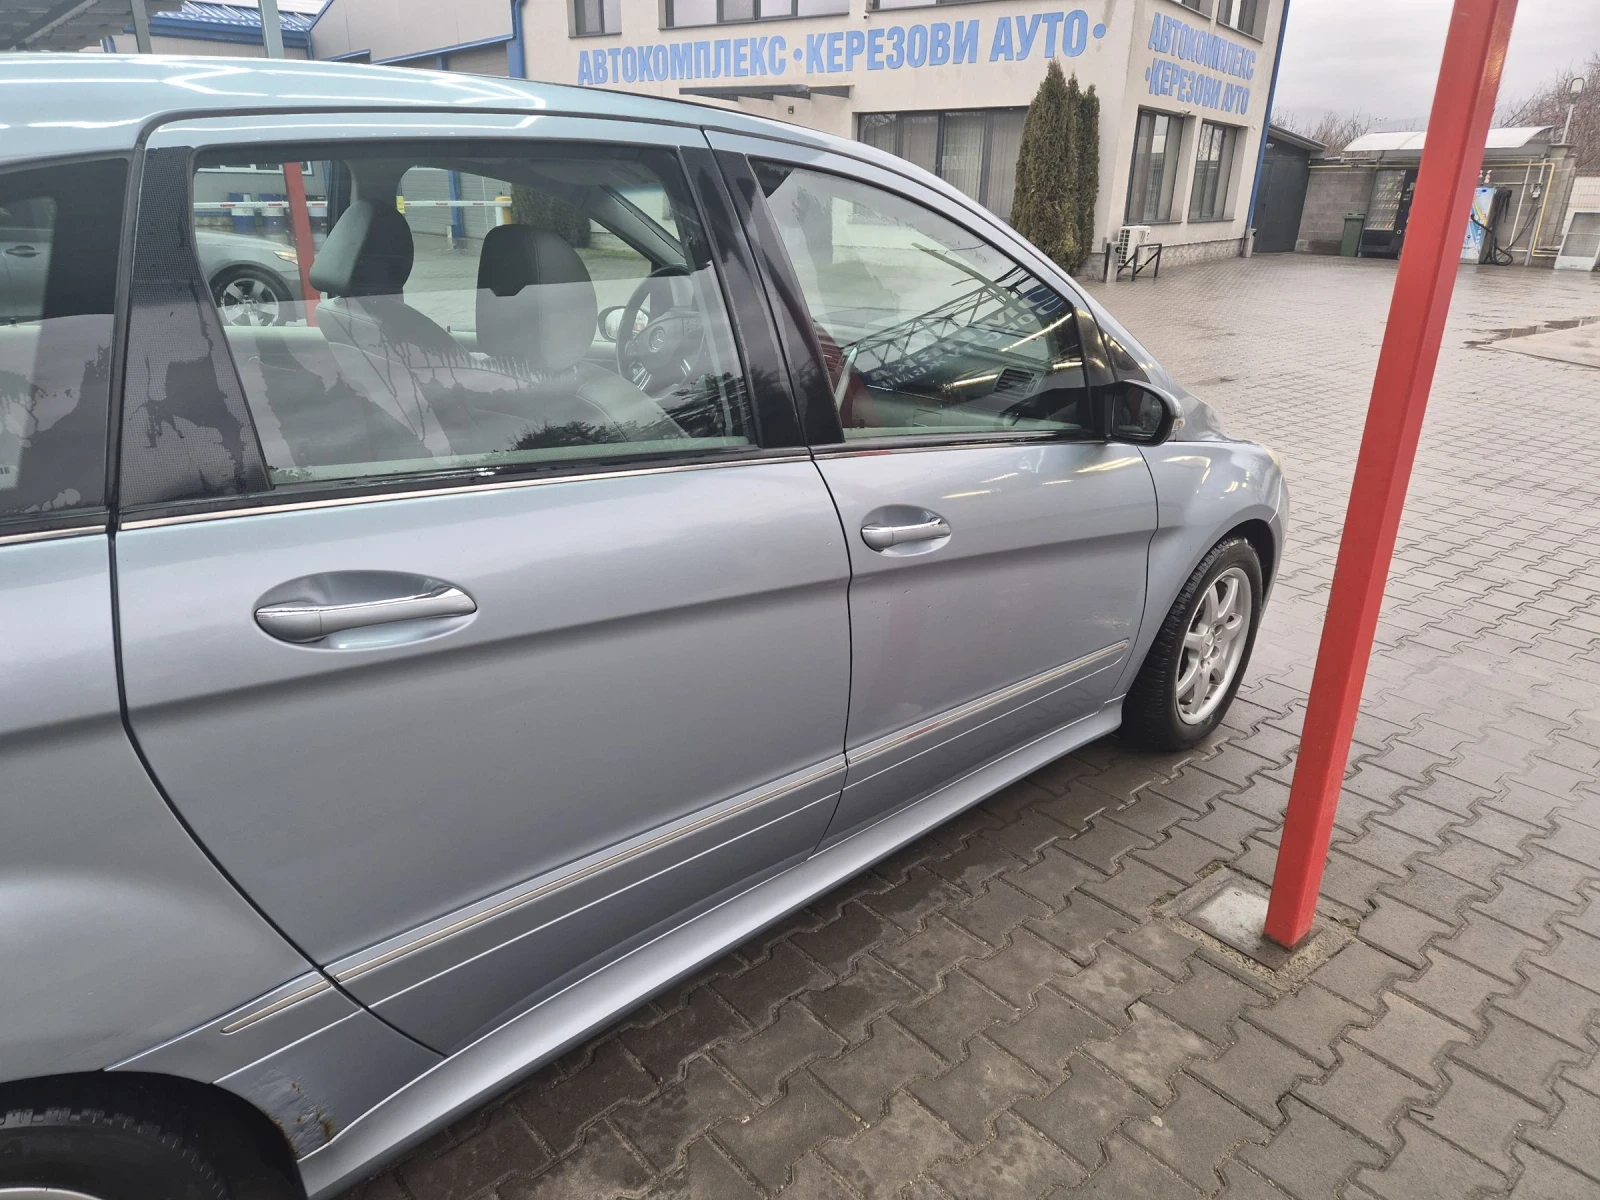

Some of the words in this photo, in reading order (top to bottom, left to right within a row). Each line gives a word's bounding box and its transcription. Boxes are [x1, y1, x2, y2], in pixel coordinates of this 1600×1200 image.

[578, 35, 786, 85] АВТОКОМПЛЕКС
[806, 19, 979, 74] КЕРЕЗОВИ
[989, 9, 1088, 62] АУТО
[1148, 12, 1256, 80] АВТОКОМПЛЕКС
[1149, 58, 1222, 109] КЕРЕЗОВИ
[1221, 83, 1250, 115] АУТО
